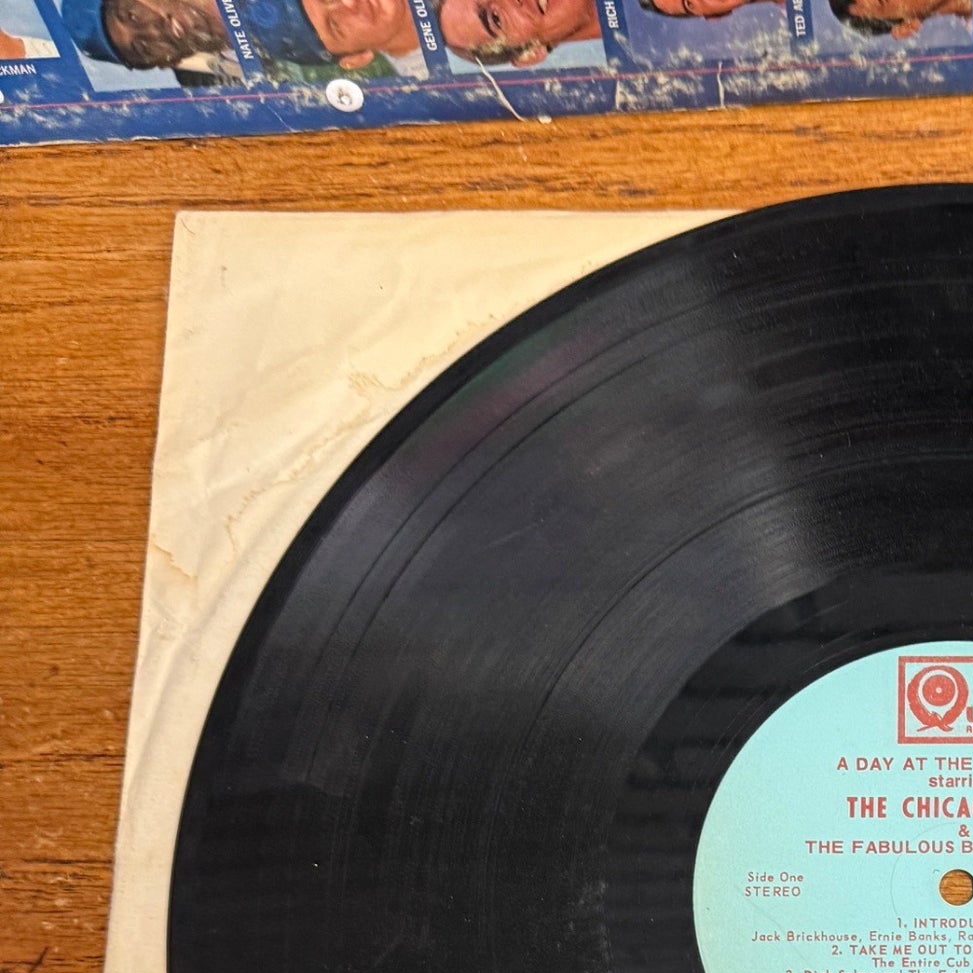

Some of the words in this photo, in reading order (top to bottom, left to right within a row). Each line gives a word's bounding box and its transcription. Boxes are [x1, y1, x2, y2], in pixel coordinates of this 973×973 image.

[604, 1, 619, 29] RICH
[794, 15, 807, 37] TED
[420, 20, 438, 51] GENE
[233, 30, 254, 60] NATE
[837, 757, 848, 770] A
[856, 757, 894, 771] DAY
[903, 757, 928, 771] AT
[934, 757, 972, 770] THE
[847, 797, 887, 818] THE
[958, 824, 970, 837] &
[805, 840, 844, 854] THE
[852, 840, 954, 854] FABULOUS
[748, 871, 774, 882] Side
[780, 872, 804, 882] One
[745, 886, 800, 897] STEREO
[897, 918, 907, 928] 1.
[752, 931, 780, 942] Jack
[787, 931, 862, 943] Brickhouse,
[869, 931, 902, 941] Ernie
[909, 931, 951, 943] Banks,
[832, 945, 842, 955] 2.
[849, 944, 887, 955] TAKE
[893, 945, 912, 955] ME
[918, 944, 947, 955] OUT
[954, 944, 972, 955] TO
[872, 957, 895, 968] The
[902, 957, 940, 967] Entire
[946, 957, 970, 967] Cub
